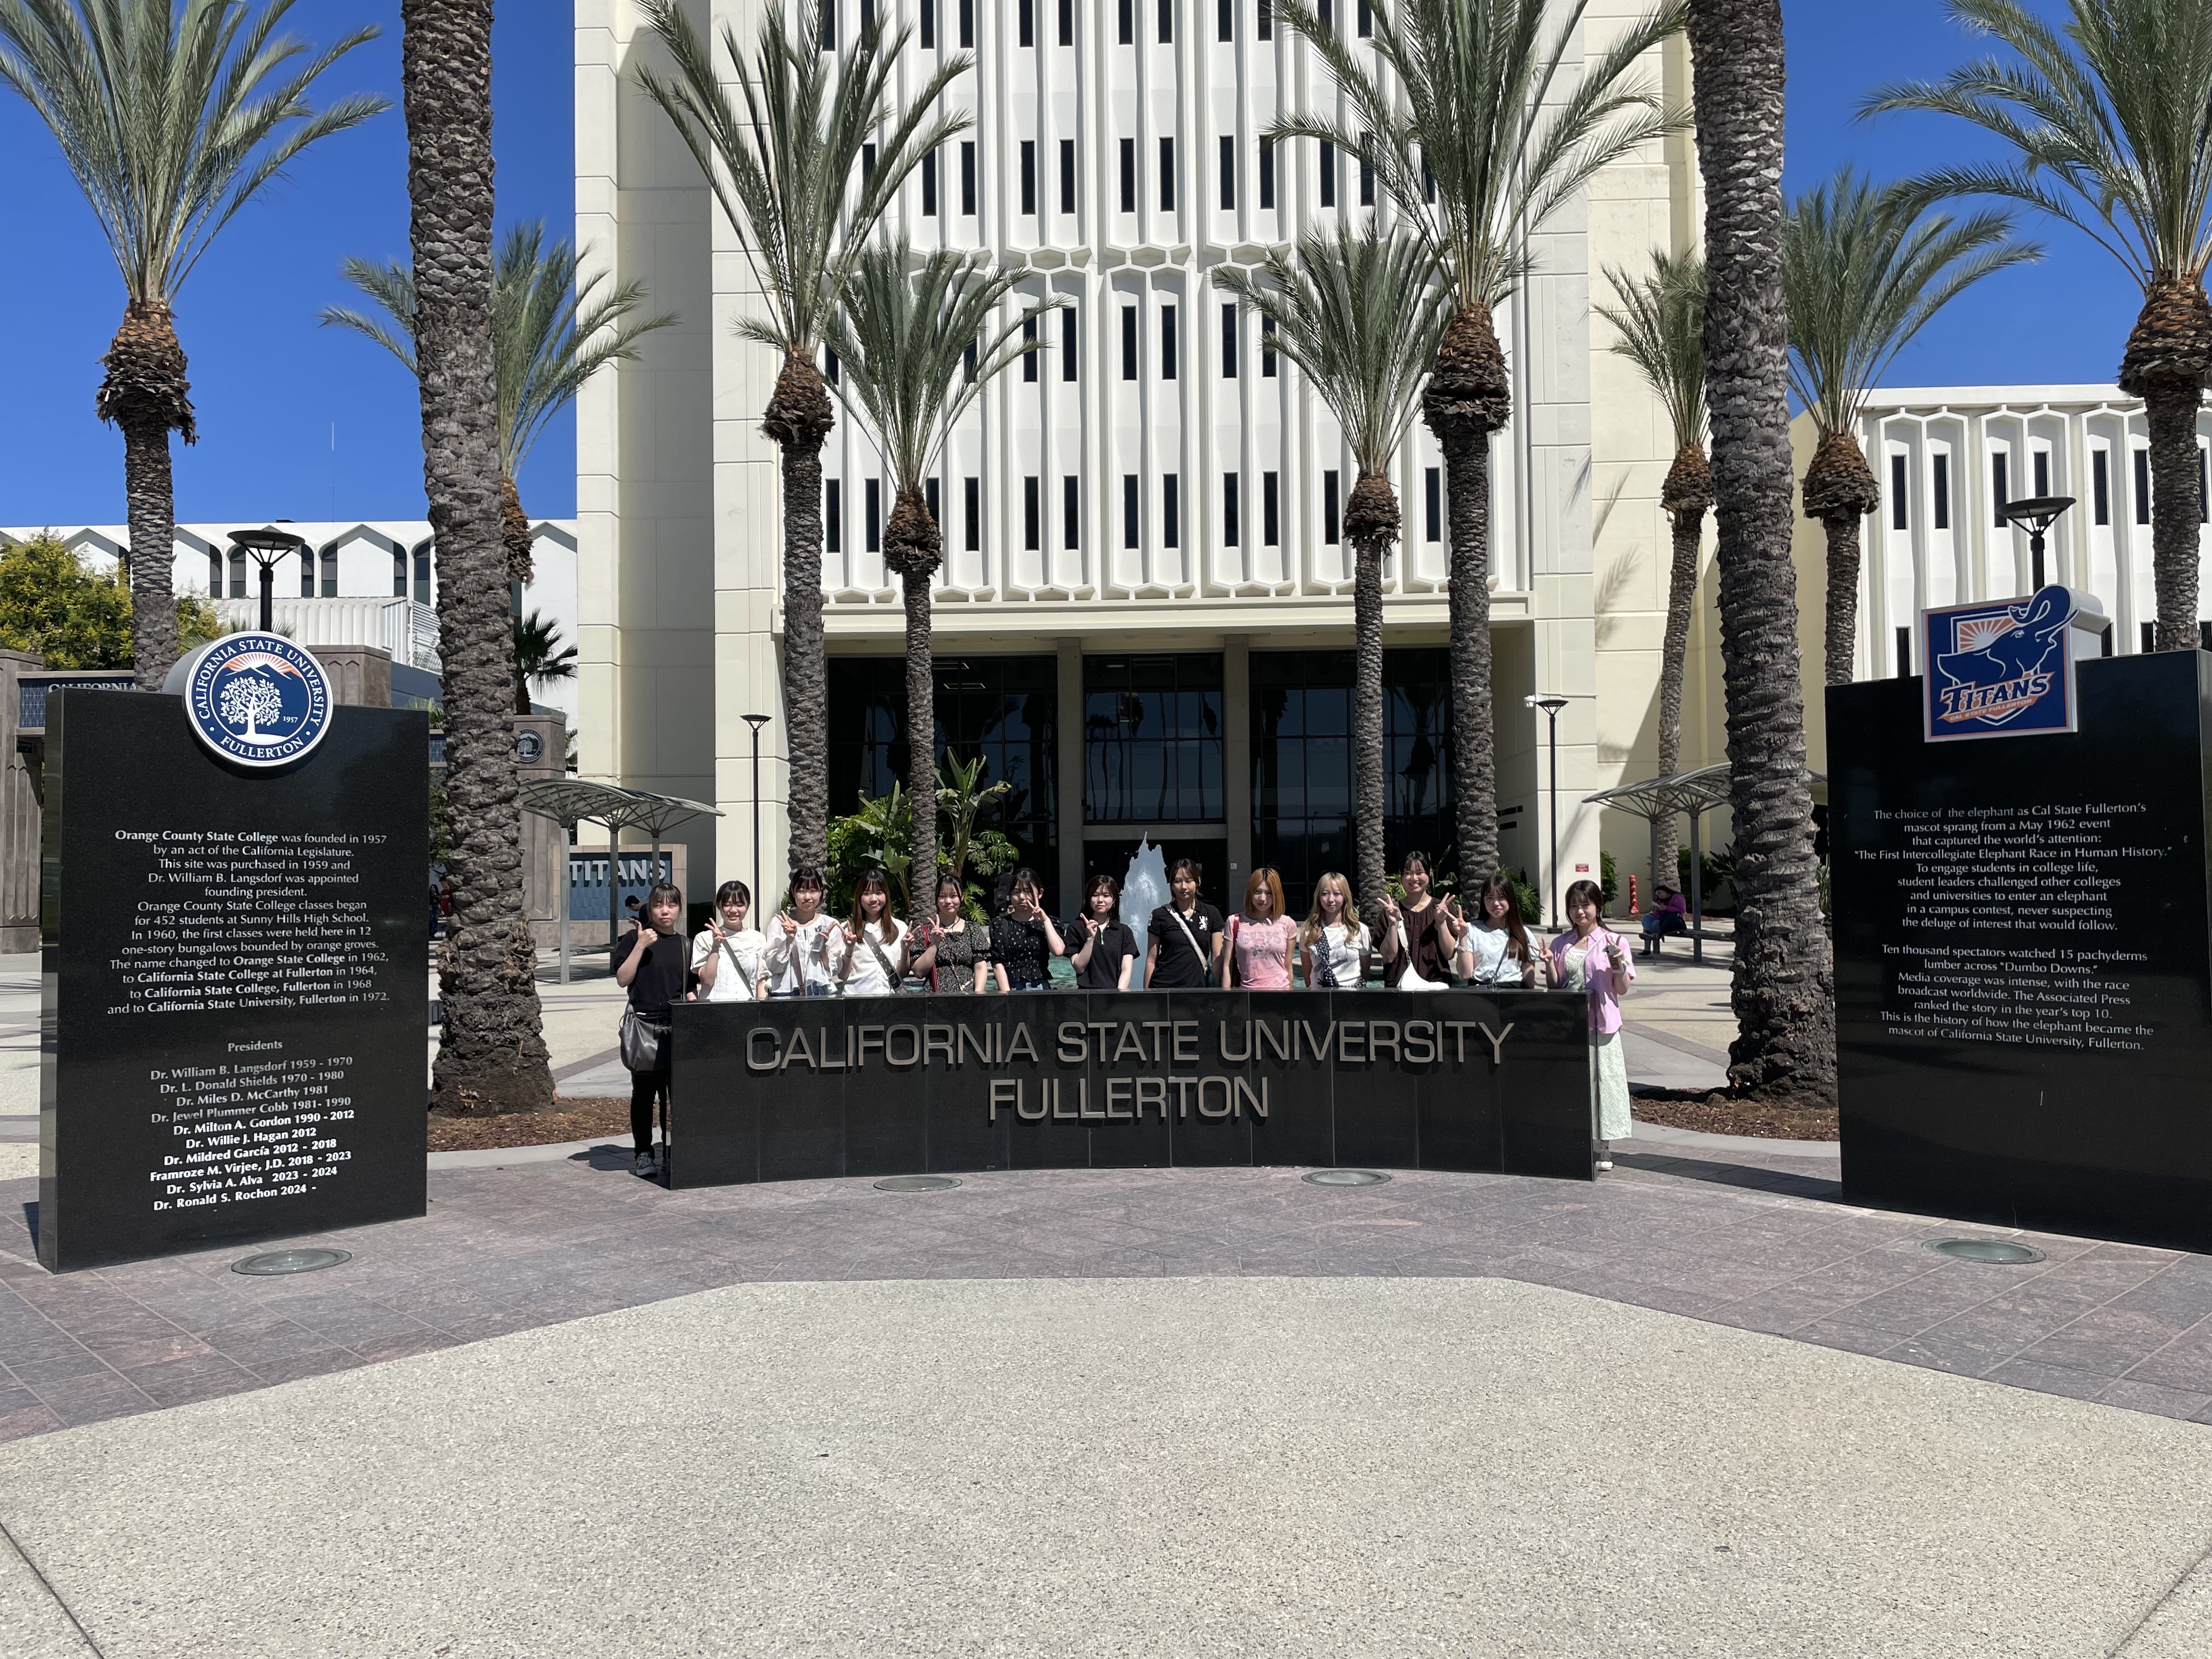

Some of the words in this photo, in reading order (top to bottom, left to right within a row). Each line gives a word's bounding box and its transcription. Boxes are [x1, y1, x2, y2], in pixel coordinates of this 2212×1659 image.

[196, 645, 237, 719] CALIFORNIA
[239, 639, 284, 654] STATE
[286, 649, 325, 727] UNIVERSITY
[1942, 675, 2049, 714] TITANS
[1965, 709, 1987, 718] STATE
[1988, 699, 2033, 712] FULLERTON
[283, 715, 298, 724] 1957
[219, 736, 304, 758] FULLERTON
[1874, 809, 1892, 820] The
[1895, 809, 1928, 819] choice
[1931, 808, 1942, 818] of
[1948, 808, 1965, 817] the
[1967, 806, 2013, 820] elephant
[2032, 804, 2050, 815] Cal
[2055, 805, 2082, 815] State
[1904, 823, 1940, 832] mascot
[1943, 823, 1978, 834] sprang
[1981, 821, 2006, 831] from
[2019, 820, 2043, 832] May
[2047, 819, 2075, 830] 1962
[2079, 819, 2110, 828] event
[115, 830, 159, 843] Orange
[162, 831, 204, 843] County
[207, 831, 235, 841] State
[238, 832, 278, 845] College
[304, 833, 346, 843] founded
[349, 834, 358, 843] in
[363, 835, 387, 844] 1957
[1912, 836, 1932, 845] that
[1934, 834, 1980, 848] captured
[1984, 834, 2001, 845] the
[2047, 833, 2101, 844] attention:
[154, 844, 168, 857] by
[188, 846, 205, 855] act
[207, 844, 220, 855] of
[222, 845, 239, 855] the
[242, 845, 294, 856] California
[297, 847, 354, 859] Legislature.
[1880, 850, 1899, 859] First
[1903, 849, 1976, 861] Intercollegiate
[1979, 848, 2025, 861] Elephant
[2029, 848, 2057, 858] Race
[2061, 848, 2071, 857] in
[2075, 848, 2118, 857] Human
[158, 858, 181, 868] This
[184, 859, 204, 868] site
[230, 859, 285, 872] purchased
[289, 860, 298, 869] in
[302, 860, 328, 870] 1959
[331, 860, 350, 870] and
[148, 873, 165, 883] Dr.
[168, 872, 212, 883] William
[216, 873, 227, 883] B.
[231, 873, 283, 885] Langsdorf
[308, 873, 359, 885] appointed
[1898, 876, 1934, 886] student
[1938, 876, 1975, 887] leaders
[1978, 876, 2038, 889] challenged
[2041, 876, 2070, 887] other
[2073, 876, 2121, 889] colleges
[205, 886, 253, 899] founding
[256, 887, 307, 899] president.
[138, 901, 180, 913] Orange
[183, 901, 223, 913] County
[226, 901, 252, 910] State
[255, 900, 296, 913] College
[298, 900, 334, 910] classes
[336, 900, 366, 912] began
[135, 915, 151, 926] for
[154, 916, 175, 925] 452
[179, 914, 224, 925] students
[227, 916, 238, 924] at
[240, 914, 274, 926] Sunny
[277, 913, 301, 923] Hills
[304, 913, 329, 926] High
[332, 912, 369, 923] School.
[1882, 944, 1899, 953] Ten
[1903, 944, 1949, 956] thousand
[1953, 948, 2006, 959] spectators
[2008, 948, 2056, 958] watched
[2060, 949, 2073, 959] 15
[2078, 949, 2147, 963] pachyderms
[1898, 972, 1931, 982] Media
[1933, 975, 1981, 986] coverage
[2008, 978, 2050, 989] intense,
[2054, 978, 2079, 988] with
[2083, 978, 2101, 989] the
[1898, 984, 1947, 996] broadcast
[1950, 988, 2011, 1000] worldwide.
[2013, 990, 2034, 1001] The
[2036, 992, 2097, 1003] Associated
[2101, 994, 2130, 1005] Press
[228, 1040, 283, 1052] Presidents
[745, 1022, 1039, 1070] CALIFORNIA
[1057, 1020, 1200, 1063] STATE
[1221, 1020, 1515, 1064] UNIVERSITY
[150, 1070, 168, 1080] Dr.
[171, 1066, 216, 1078] William
[219, 1065, 230, 1075] B.
[234, 1060, 287, 1075] Langsdorf
[290, 1059, 316, 1069] 1959
[327, 1056, 353, 1066] 1970
[176, 1097, 194, 1107] Dr.
[197, 1093, 228, 1105] Miles
[231, 1092, 244, 1102] D.
[247, 1087, 300, 1101] McCarthy
[303, 1085, 328, 1096] 1981
[989, 1076, 1268, 1120] FULLERTON
[173, 1125, 191, 1135] Dr.
[194, 1121, 232, 1133] Milton
[234, 1120, 246, 1130] A.
[250, 1115, 291, 1128] Gordon
[295, 1113, 321, 1124] 1990
[330, 1109, 354, 1120] 2012
[186, 1139, 204, 1149] Dr.
[207, 1135, 240, 1146] Willie
[242, 1133, 250, 1145] J.
[253, 1132, 289, 1143] Hagan
[291, 1127, 317, 1138] 2012
[164, 1155, 183, 1166] Dr.
[186, 1149, 231, 1164] Mildred
[273, 1143, 298, 1154] 2012
[312, 1138, 337, 1150] 2018
[150, 1169, 205, 1182] Framroze
[207, 1165, 222, 1176] M.
[224, 1162, 262, 1175] Virjee,
[265, 1158, 285, 1171] J.D.
[288, 1155, 313, 1166] 2018
[326, 1150, 352, 1162] 2023
